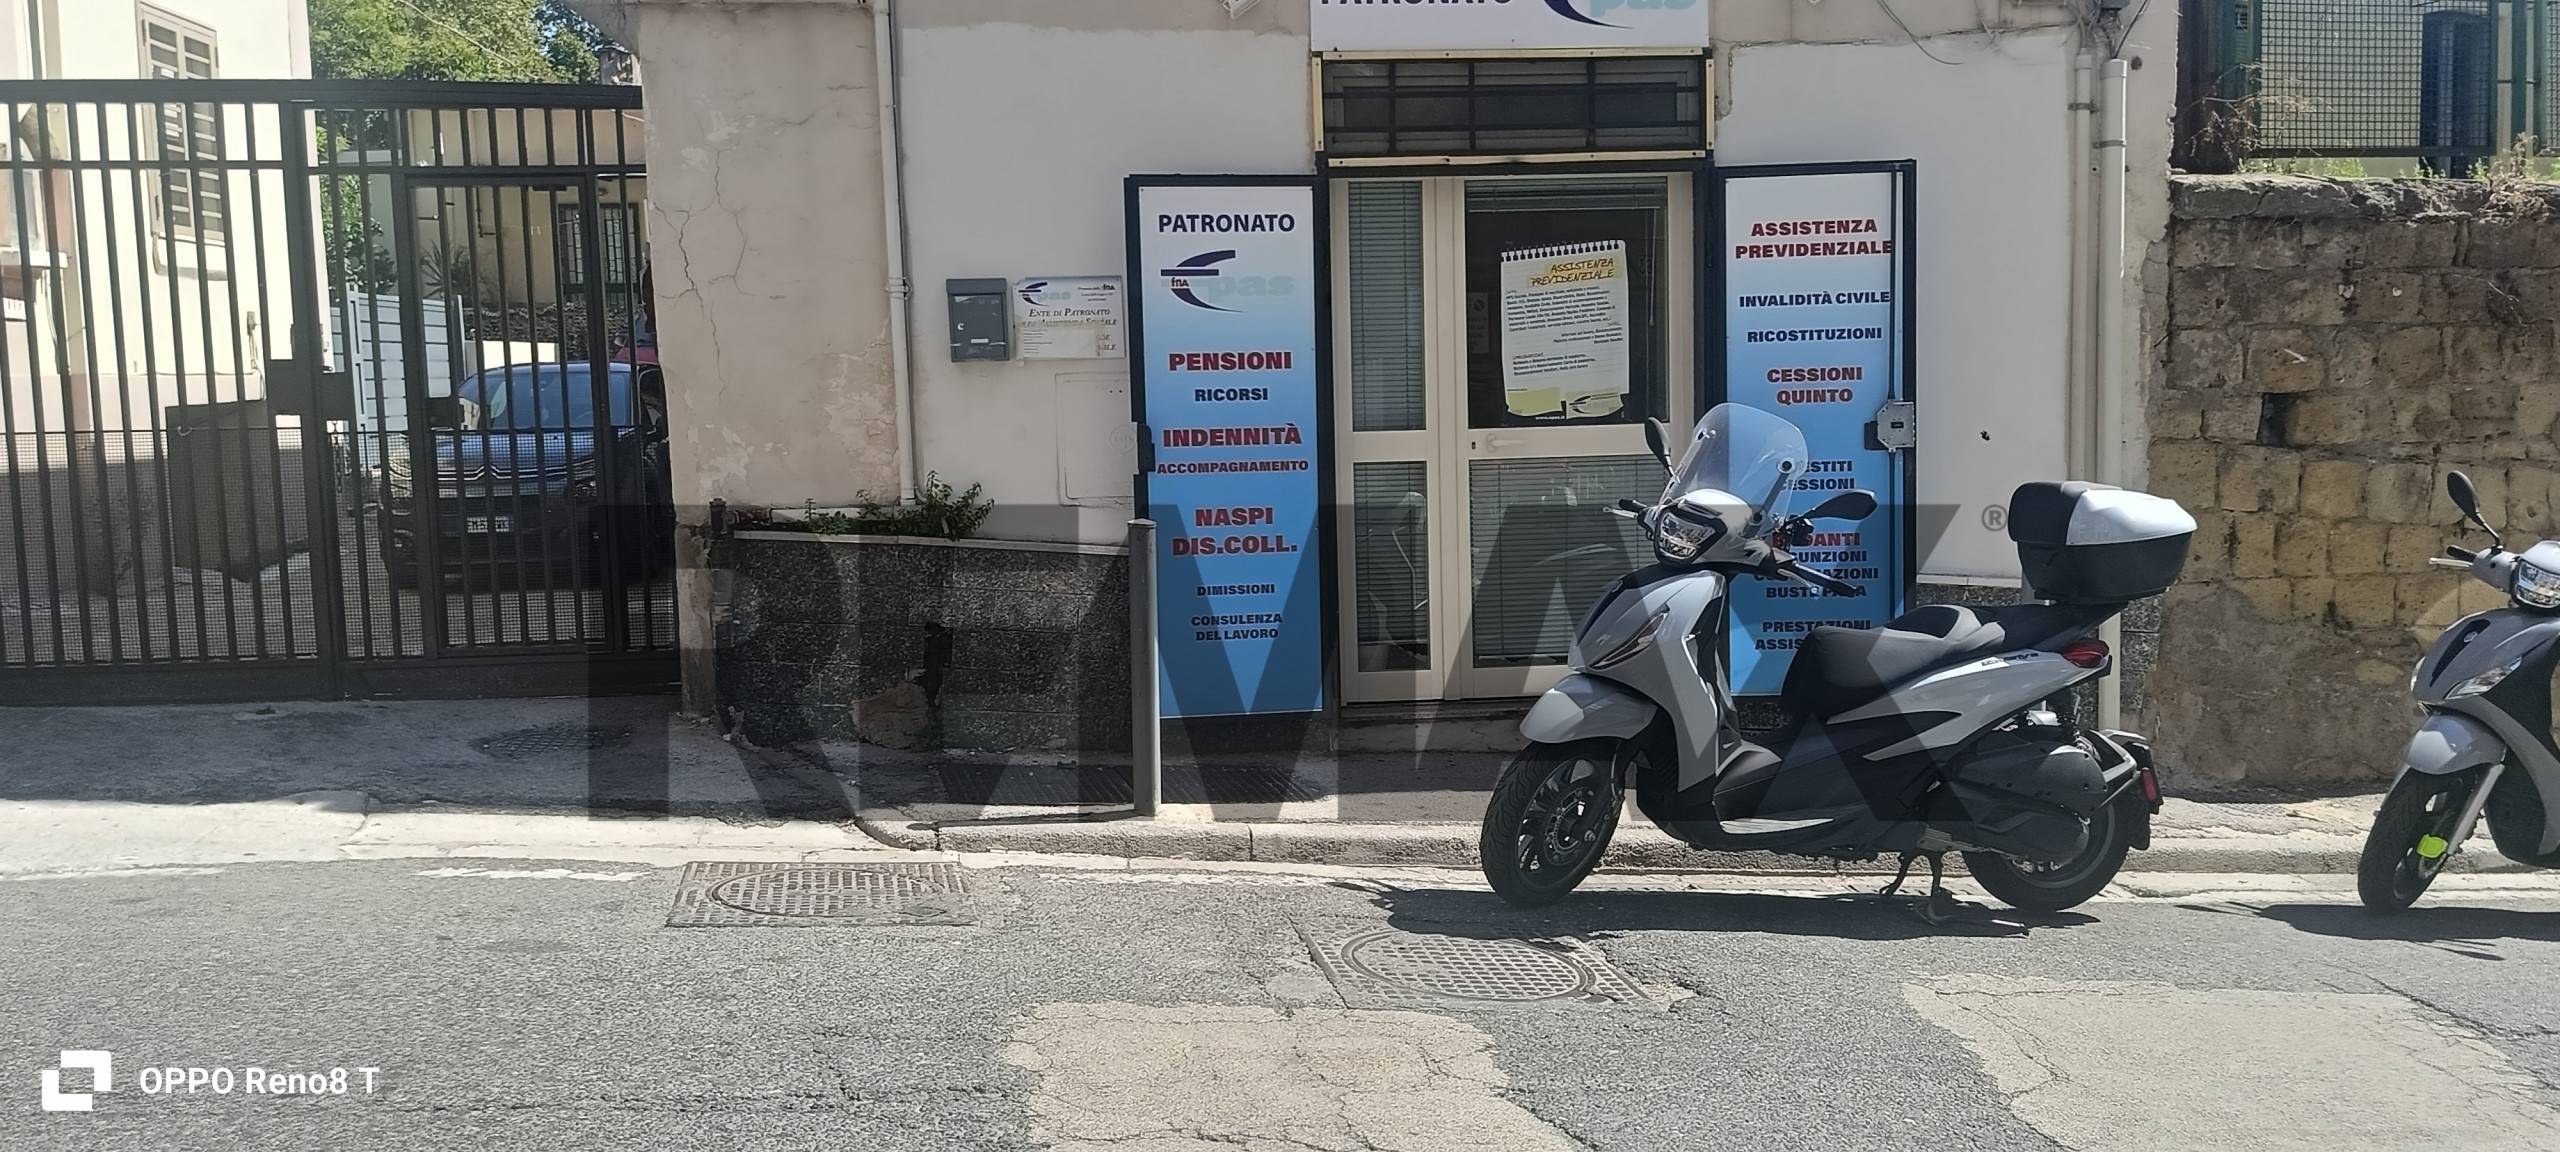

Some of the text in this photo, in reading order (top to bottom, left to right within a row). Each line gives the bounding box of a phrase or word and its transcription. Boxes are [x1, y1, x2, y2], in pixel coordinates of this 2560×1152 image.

[1158, 213, 1295, 233] PATRONATO
[1751, 219, 1878, 237] ASSISTENZA
[1735, 240, 1893, 259] PREVIDENZIALE
[1551, 258, 1614, 273] ASSISTENZA
[1531, 269, 1615, 287] PREVIDENZIALE
[1739, 290, 1891, 308] INVALIDITÀ CIVILE
[1747, 327, 1882, 343] RICOSTITUZIONI
[1168, 351, 1293, 372] PENSIONI
[1766, 366, 1863, 383] CESSIONI
[1194, 387, 1269, 402] RICORSI
[1776, 388, 1853, 405] QUINTO
[1163, 422, 1302, 448] INDENNITÀ
[1157, 460, 1309, 474] ACCOMPAGNAMENTO
[1195, 507, 1274, 527] NASPI
[1172, 535, 1298, 556] DIS.COLL.
[1196, 583, 1275, 596] DIMISSIONI
[1191, 613, 1283, 627] CONSULENZA
[1196, 628, 1279, 641] DEL LAVORO
